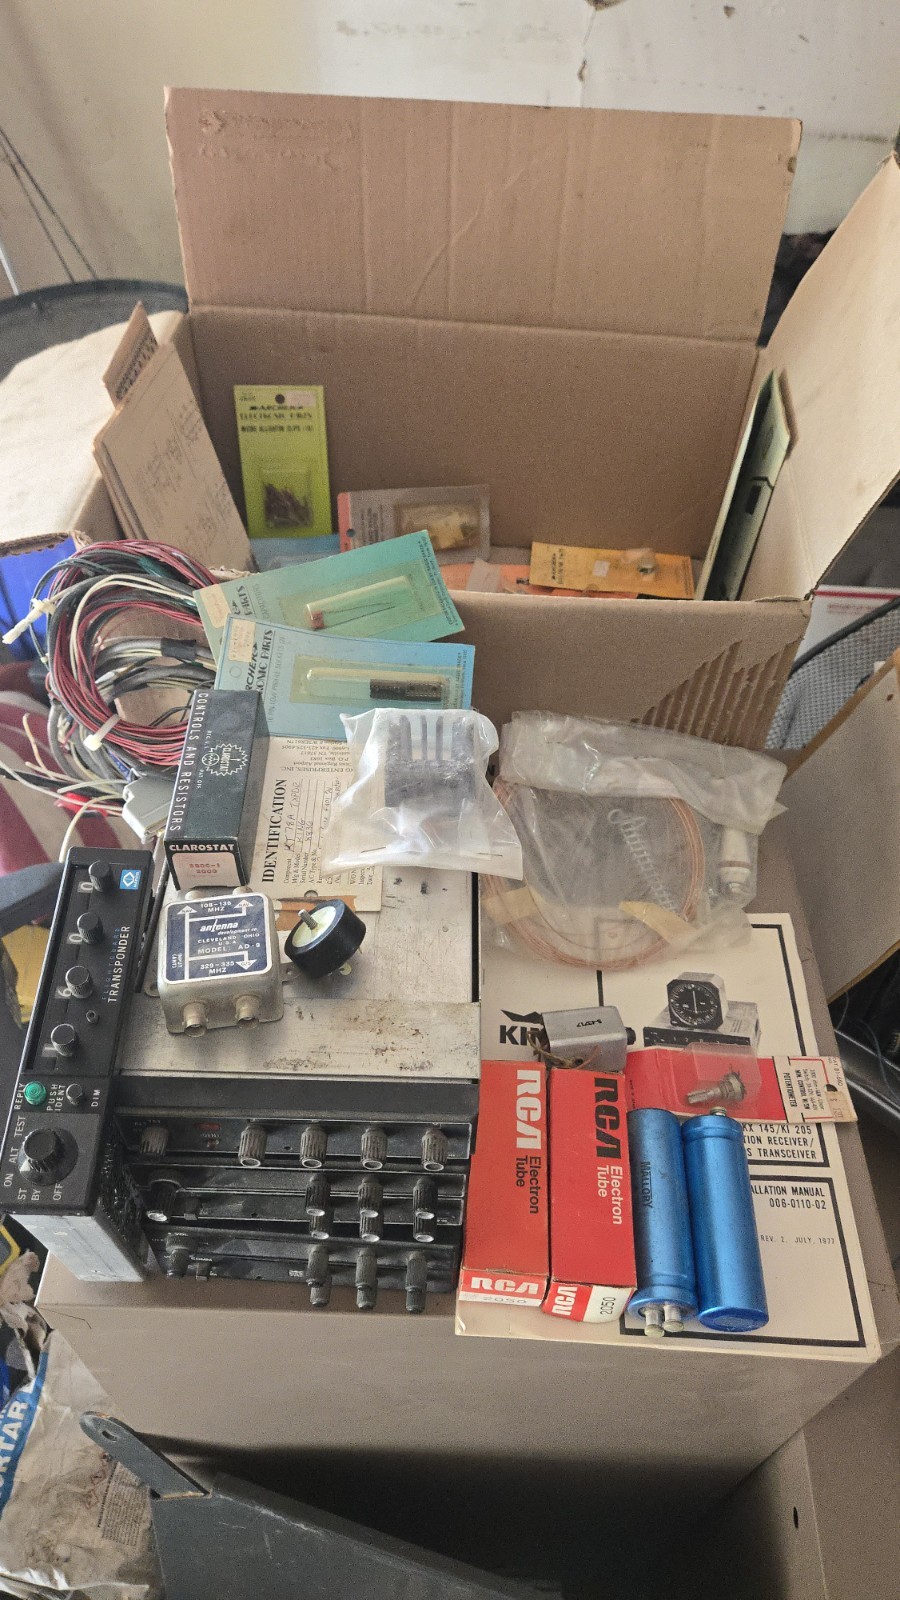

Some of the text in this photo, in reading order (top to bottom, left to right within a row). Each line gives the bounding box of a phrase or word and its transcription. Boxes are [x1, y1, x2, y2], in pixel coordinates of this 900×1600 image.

[170, 693, 208, 831] CONTROLS AND RESISTORS
[262, 779, 288, 882] IDENTIFICATION
[200, 919, 238, 932] antenna
[108, 926, 130, 1003] TRANSPONDER
[14, 1083, 25, 1110] REPLY
[47, 1084, 58, 1111] PUSH
[55, 1085, 65, 1111] IDENT
[91, 1090, 100, 1107] DIM
[783, 1072, 797, 1107] POTENTIOMETER
[516, 1070, 541, 1149] RCA
[594, 1078, 621, 1159] RCA
[14, 1116, 26, 1137] TEST
[760, 1124, 790, 1134] 145/KI
[795, 1125, 812, 1134] 205
[768, 1136, 814, 1148] RECEIVER/
[9, 1147, 19, 1163] ALT
[759, 1149, 817, 1159] TRANSCEIVER
[4, 1174, 14, 1187] ON
[516, 1155, 528, 1187] Tube
[597, 1165, 610, 1198] Tube
[18, 1188, 27, 1200] ST
[31, 1189, 41, 1200] BY
[53, 1183, 63, 1200] OFF
[530, 1156, 541, 1214] Electron
[610, 1165, 622, 1225] Electron
[640, 1161, 653, 1209] MALLORY
[750, 1185, 825, 1197] ALLATION MANUAL
[770, 1199, 826, 1210] 006-0110-02
[471, 1277, 538, 1294] RCA
[552, 1286, 578, 1316] RCA
[600, 1297, 616, 1315] 2050
